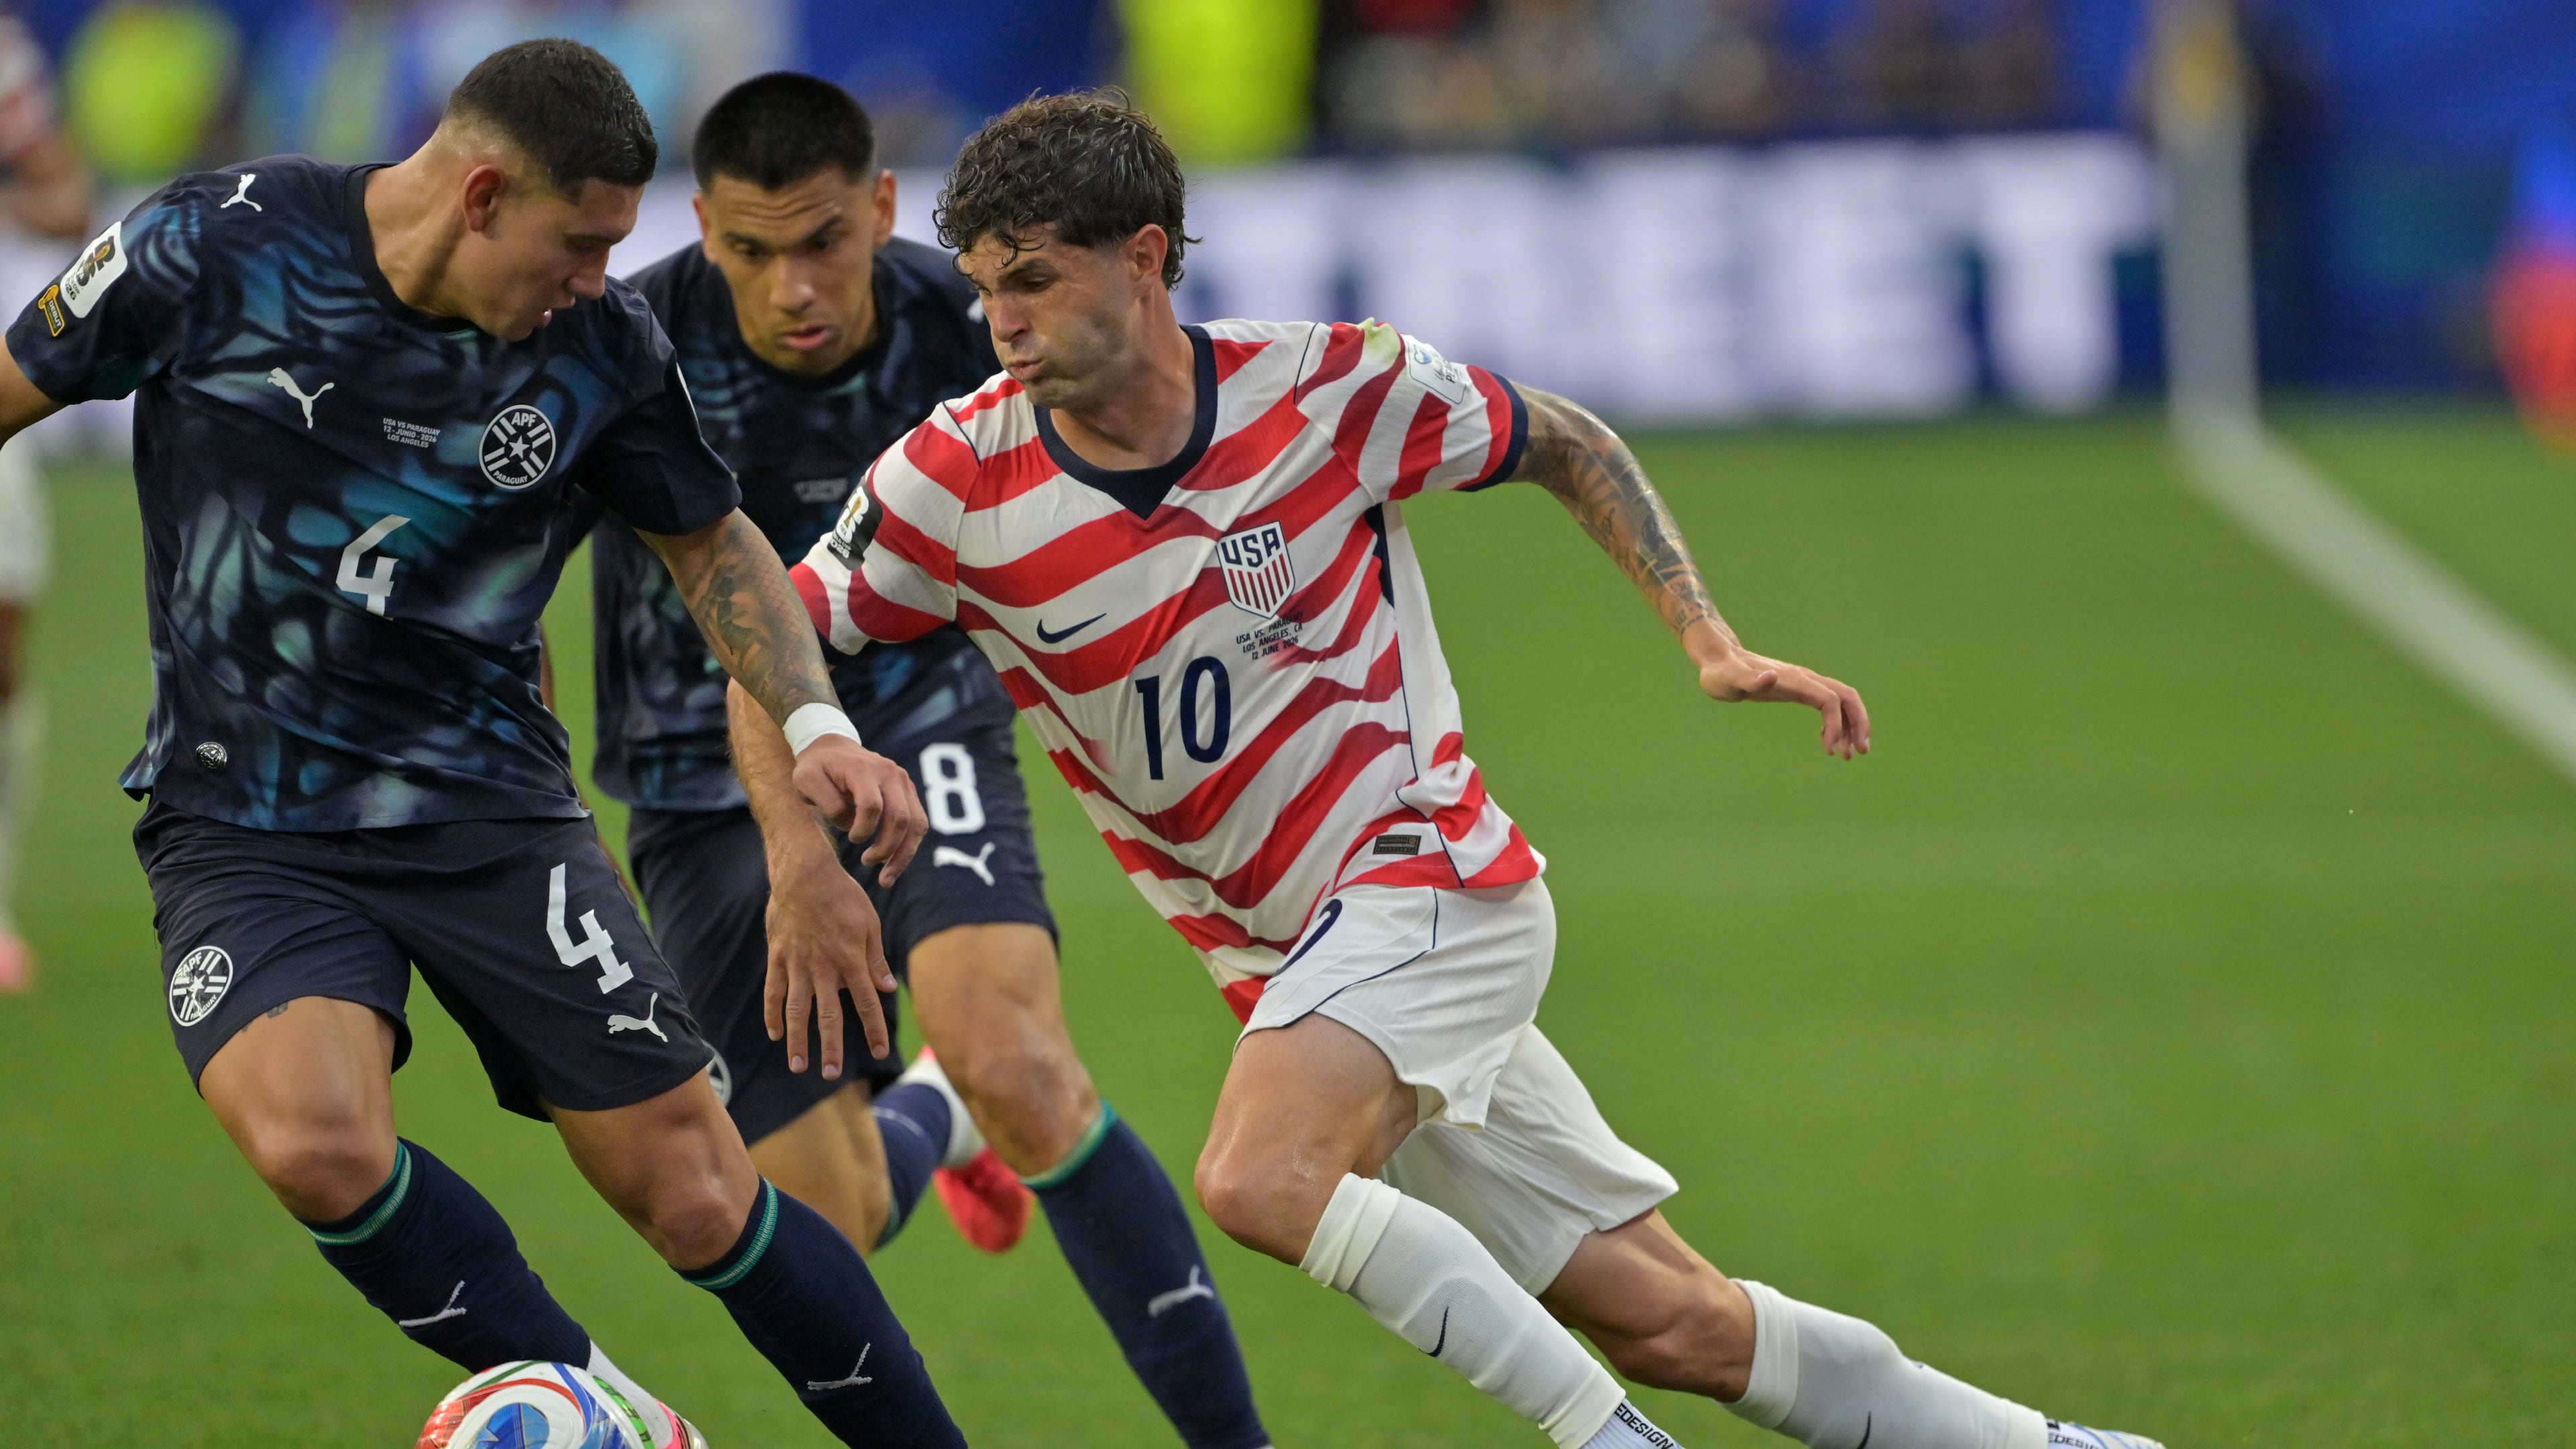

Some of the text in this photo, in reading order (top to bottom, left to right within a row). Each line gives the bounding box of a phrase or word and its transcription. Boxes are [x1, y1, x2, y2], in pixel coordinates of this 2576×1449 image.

[49, 299, 62, 327] DEBUT
[383, 417, 396, 427] USA
[407, 423, 441, 436] PARAGUAY
[511, 412, 537, 427] APF
[387, 433, 429, 448] LOS ANGELES
[395, 429, 416, 438] JUNIO
[421, 433, 437, 443] 2026
[493, 470, 529, 484] PARAGUAY
[828, 538, 851, 558] 026
[1220, 527, 1281, 568] USA
[335, 514, 411, 621] 4
[1236, 611, 1304, 644] USA VS. PARAGUAY
[1242, 623, 1303, 653] LOS ANGELES, CA
[1252, 635, 1299, 661] 12 JUNE 2026
[1135, 656, 1231, 780] 10
[918, 742, 986, 835] 8
[546, 862, 634, 994] 4
[182, 952, 202, 977] APF
[1614, 1403, 1674, 1449] EDESIGN
